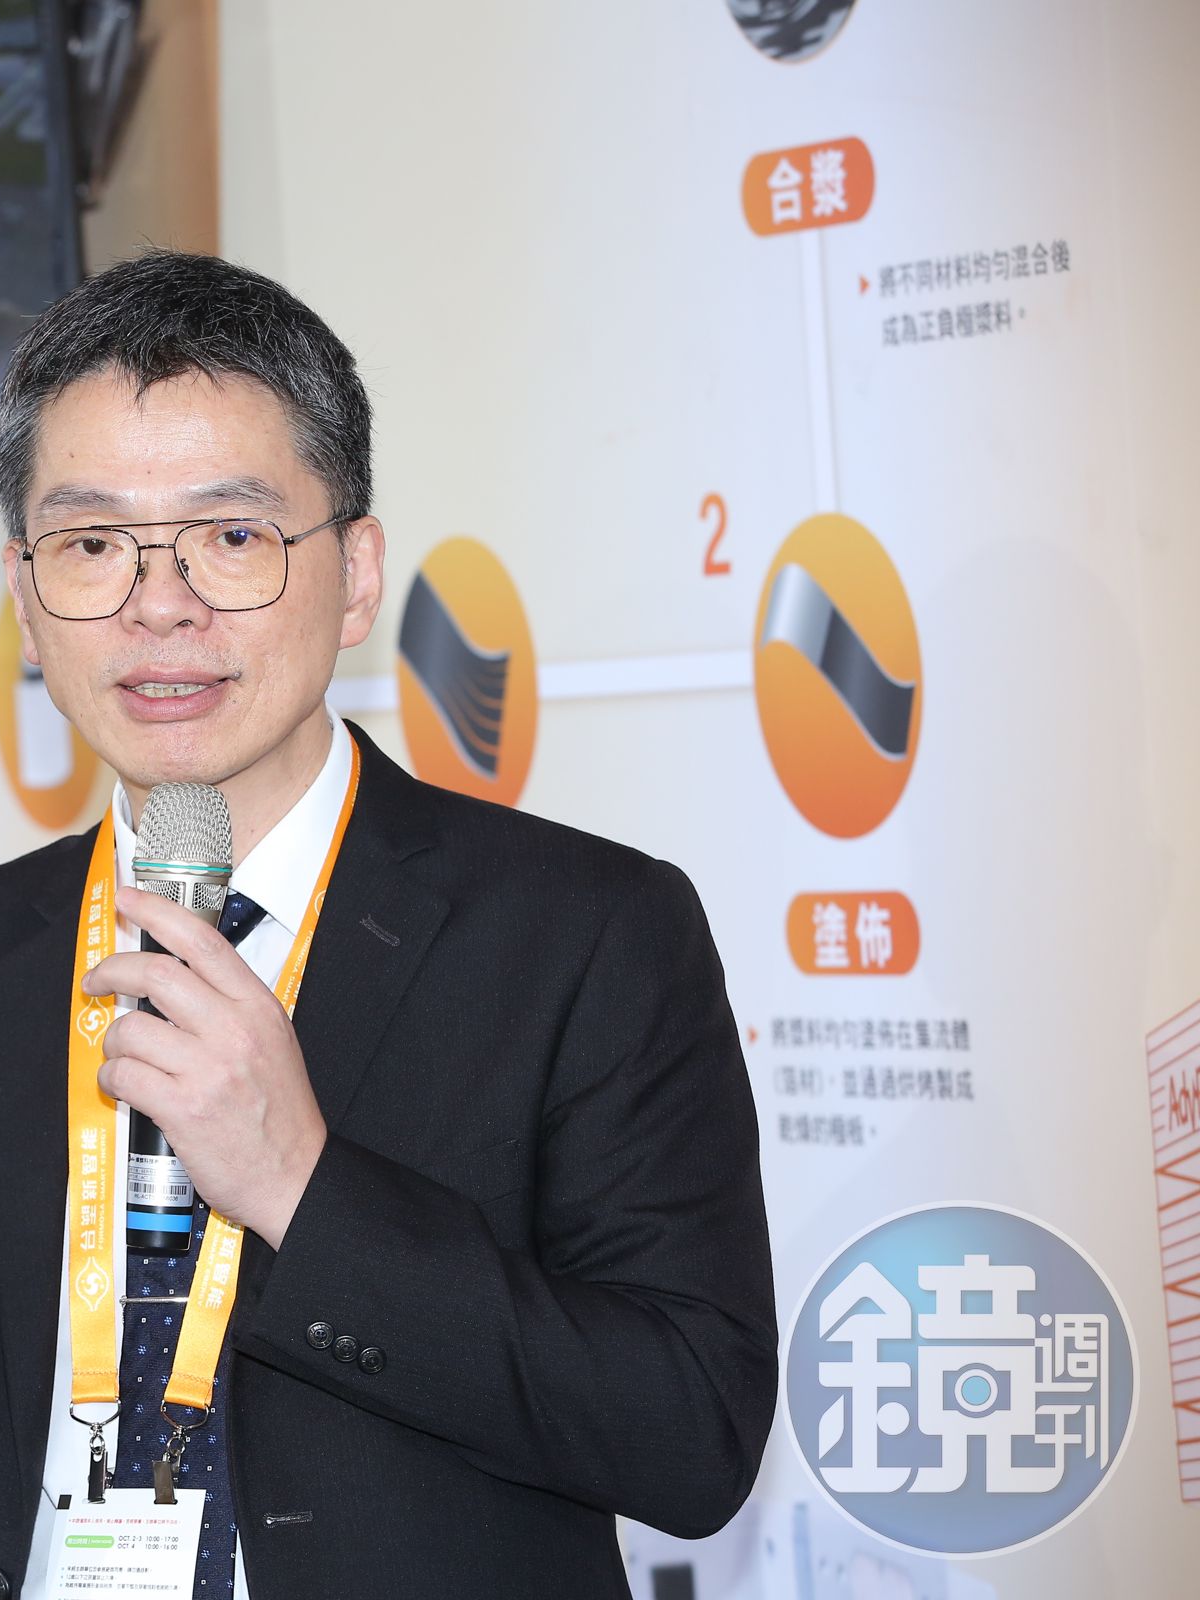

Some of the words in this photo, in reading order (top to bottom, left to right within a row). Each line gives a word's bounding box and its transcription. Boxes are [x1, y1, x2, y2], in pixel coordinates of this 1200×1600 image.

[767, 149, 848, 225] 合漿
[879, 239, 1070, 299] 將不同材料均勻混合後
[699, 490, 732, 577] 2
[86, 880, 104, 969] 塑新智能
[812, 902, 894, 969] 塗佈
[80, 1127, 98, 1250] 台塑新智能
[205, 1228, 239, 1310] 新智能
